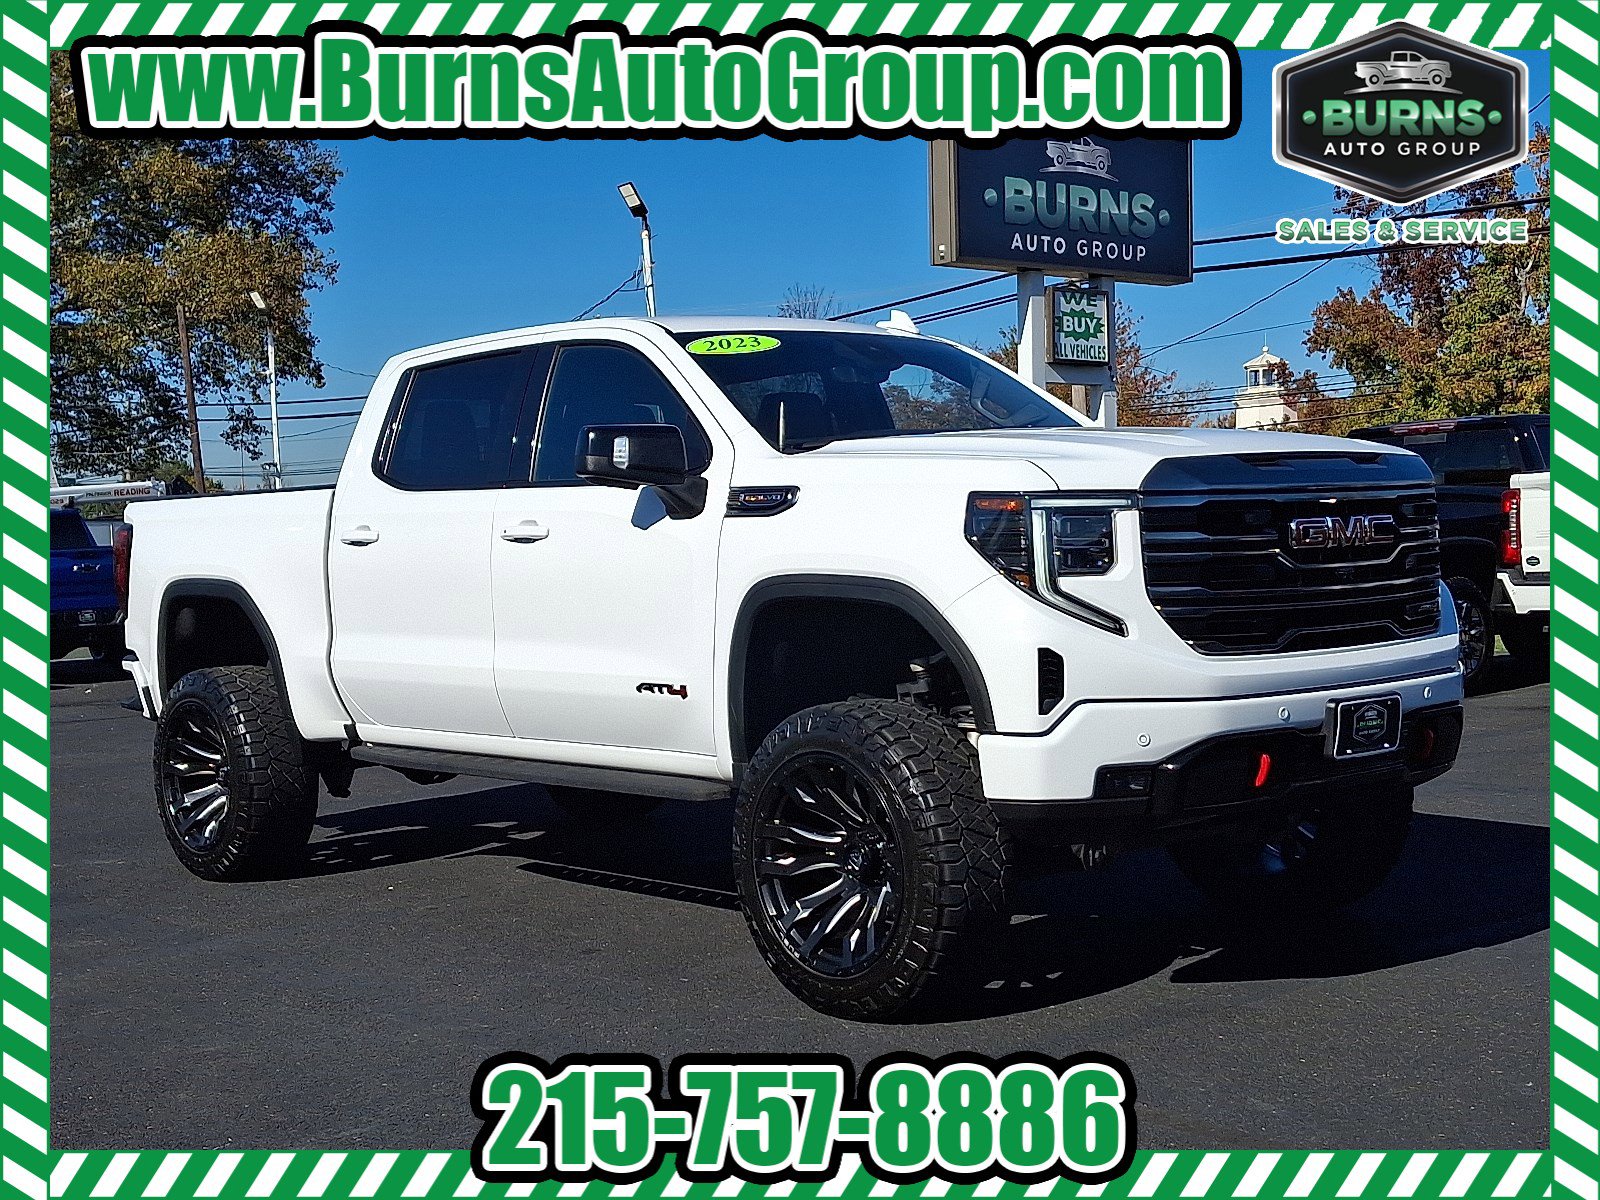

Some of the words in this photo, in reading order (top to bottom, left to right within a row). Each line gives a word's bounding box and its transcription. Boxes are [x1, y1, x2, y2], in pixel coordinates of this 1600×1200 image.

[1004, 176, 1156, 239] BURNS
[1011, 232, 1066, 255] AUTO
[1076, 239, 1146, 261] GROUP
[1060, 291, 1098, 307] WE
[1062, 315, 1098, 334] BUY
[703, 336, 761, 352] 2023
[1070, 342, 1107, 361] VEHICLES
[113, 487, 151, 497] READING
[1289, 514, 1395, 548] GMC
[635, 682, 688, 700] AT4
